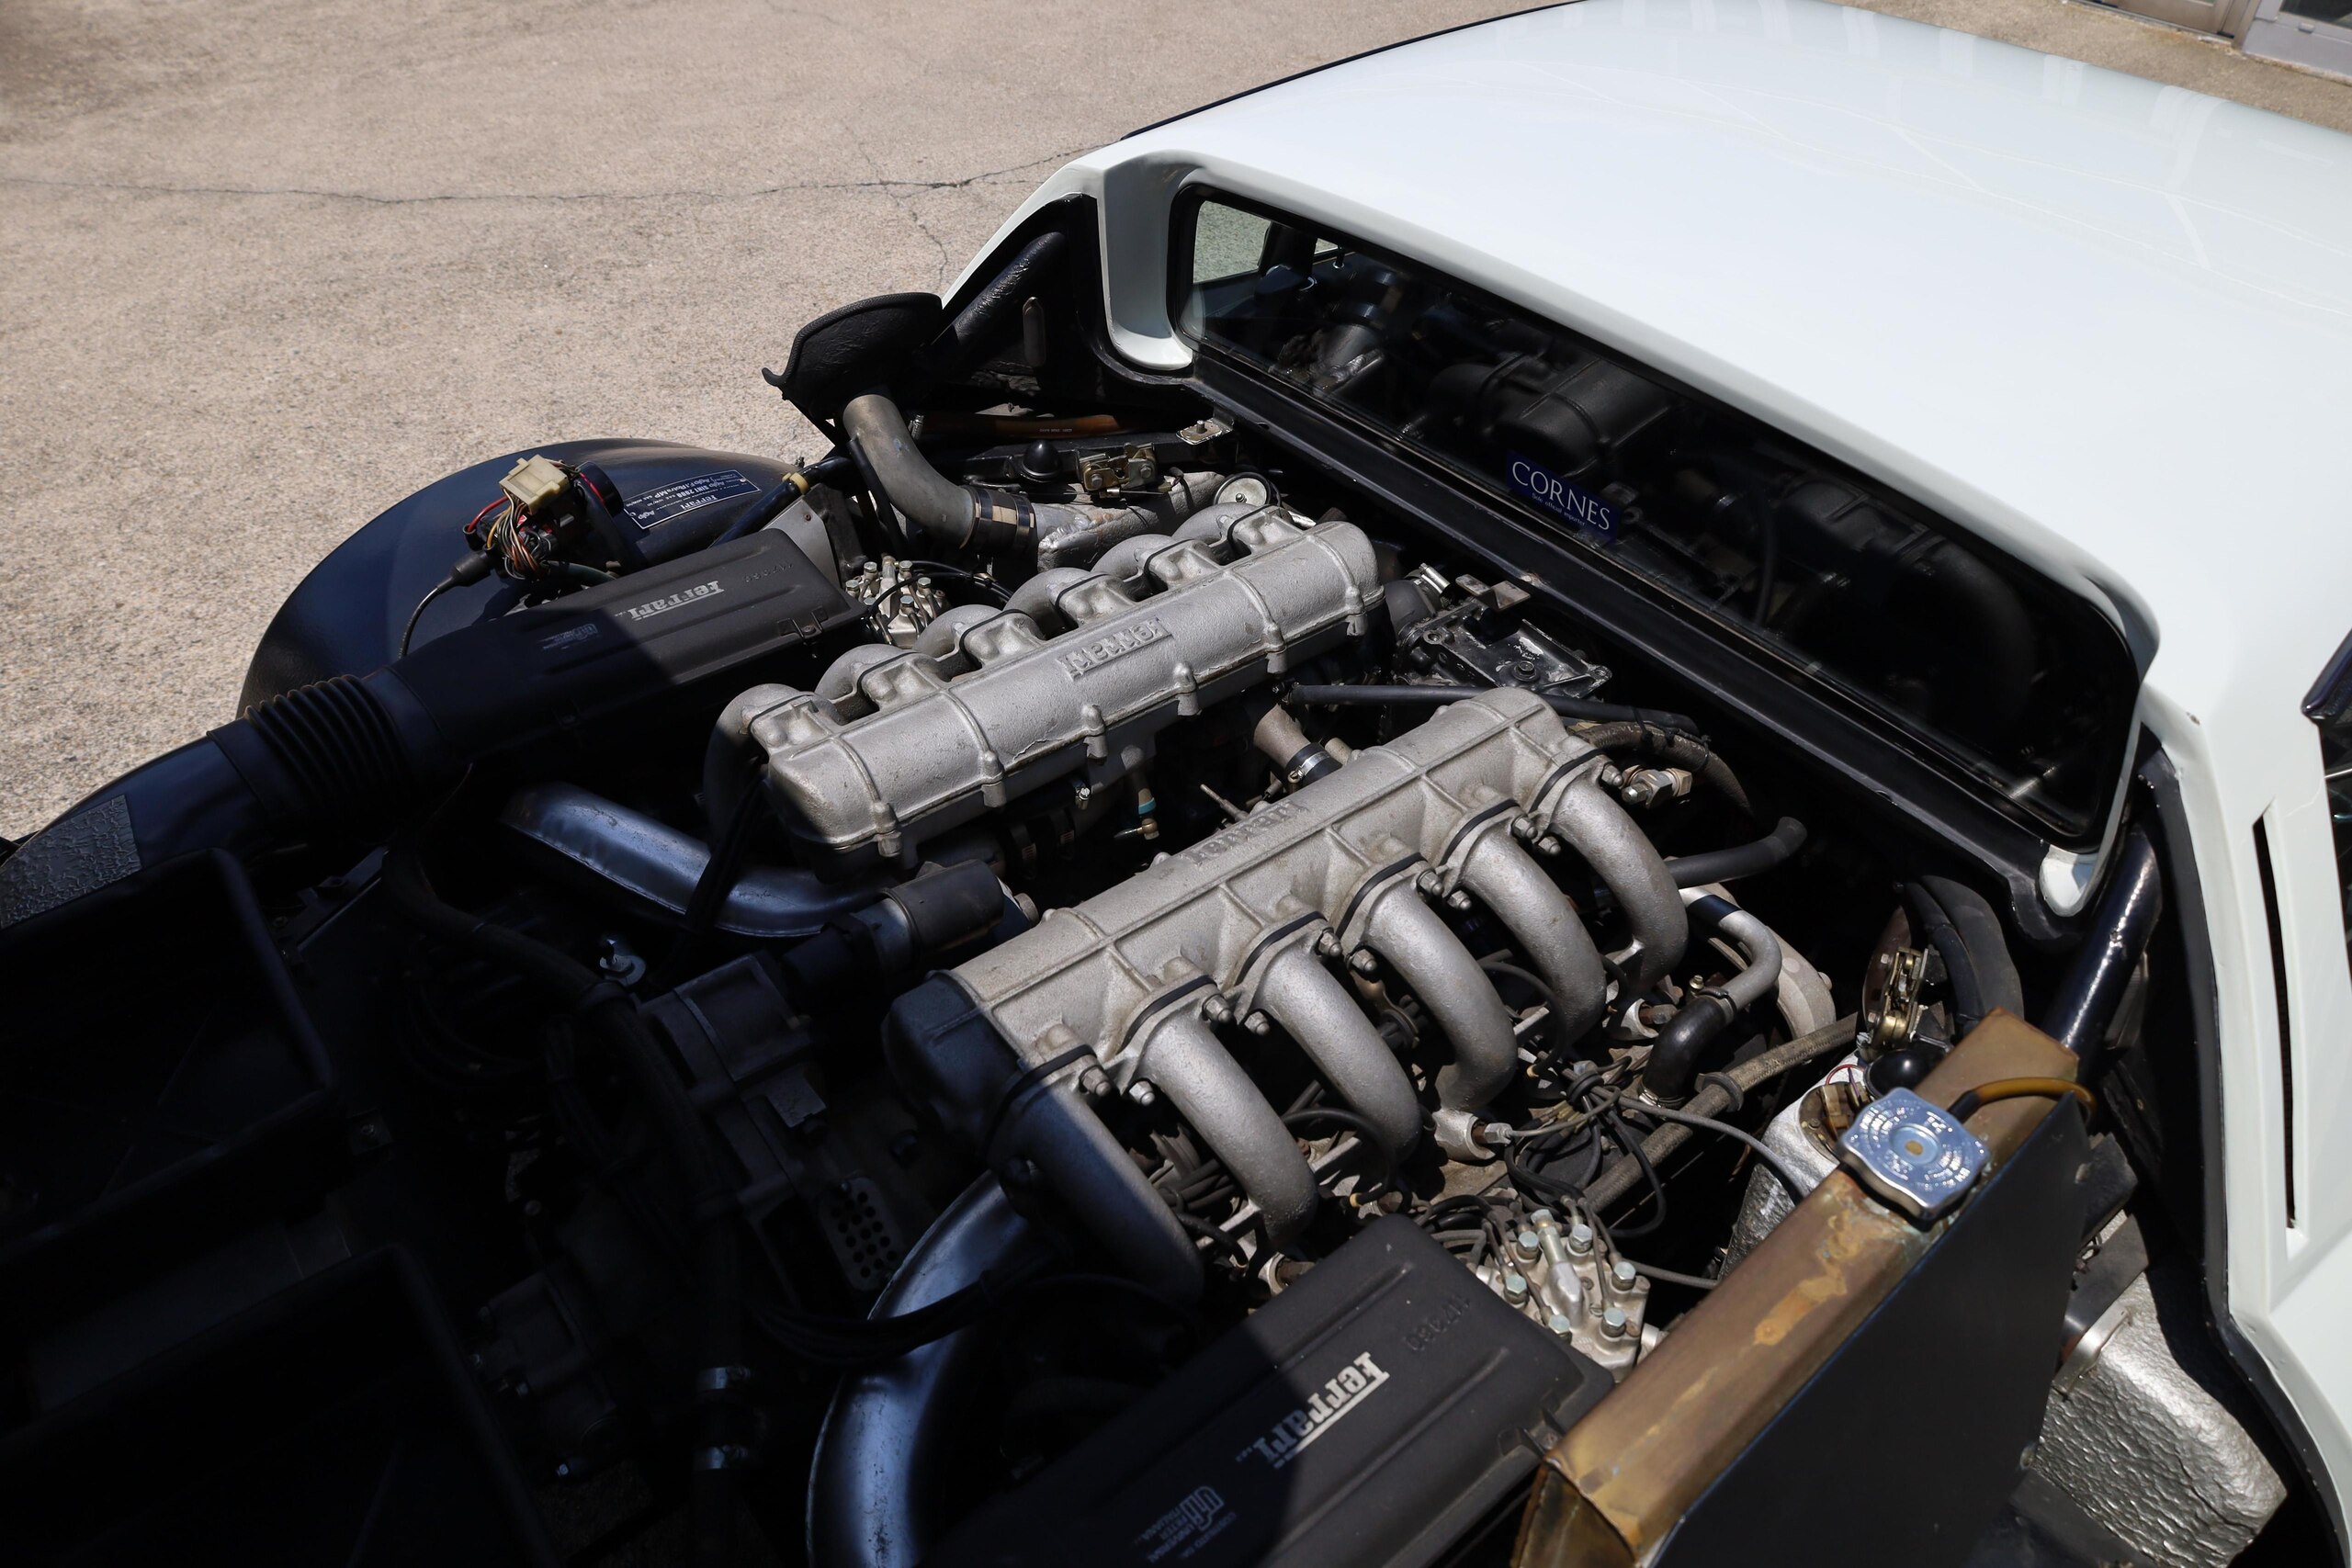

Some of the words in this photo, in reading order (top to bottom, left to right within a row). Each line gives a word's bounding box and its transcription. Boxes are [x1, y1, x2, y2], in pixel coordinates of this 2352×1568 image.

[680, 495, 718, 510] Ferrari
[1512, 461, 1610, 530] CORNES
[628, 580, 725, 621] Ferrari
[1252, 1351, 1391, 1469] Ferrari
